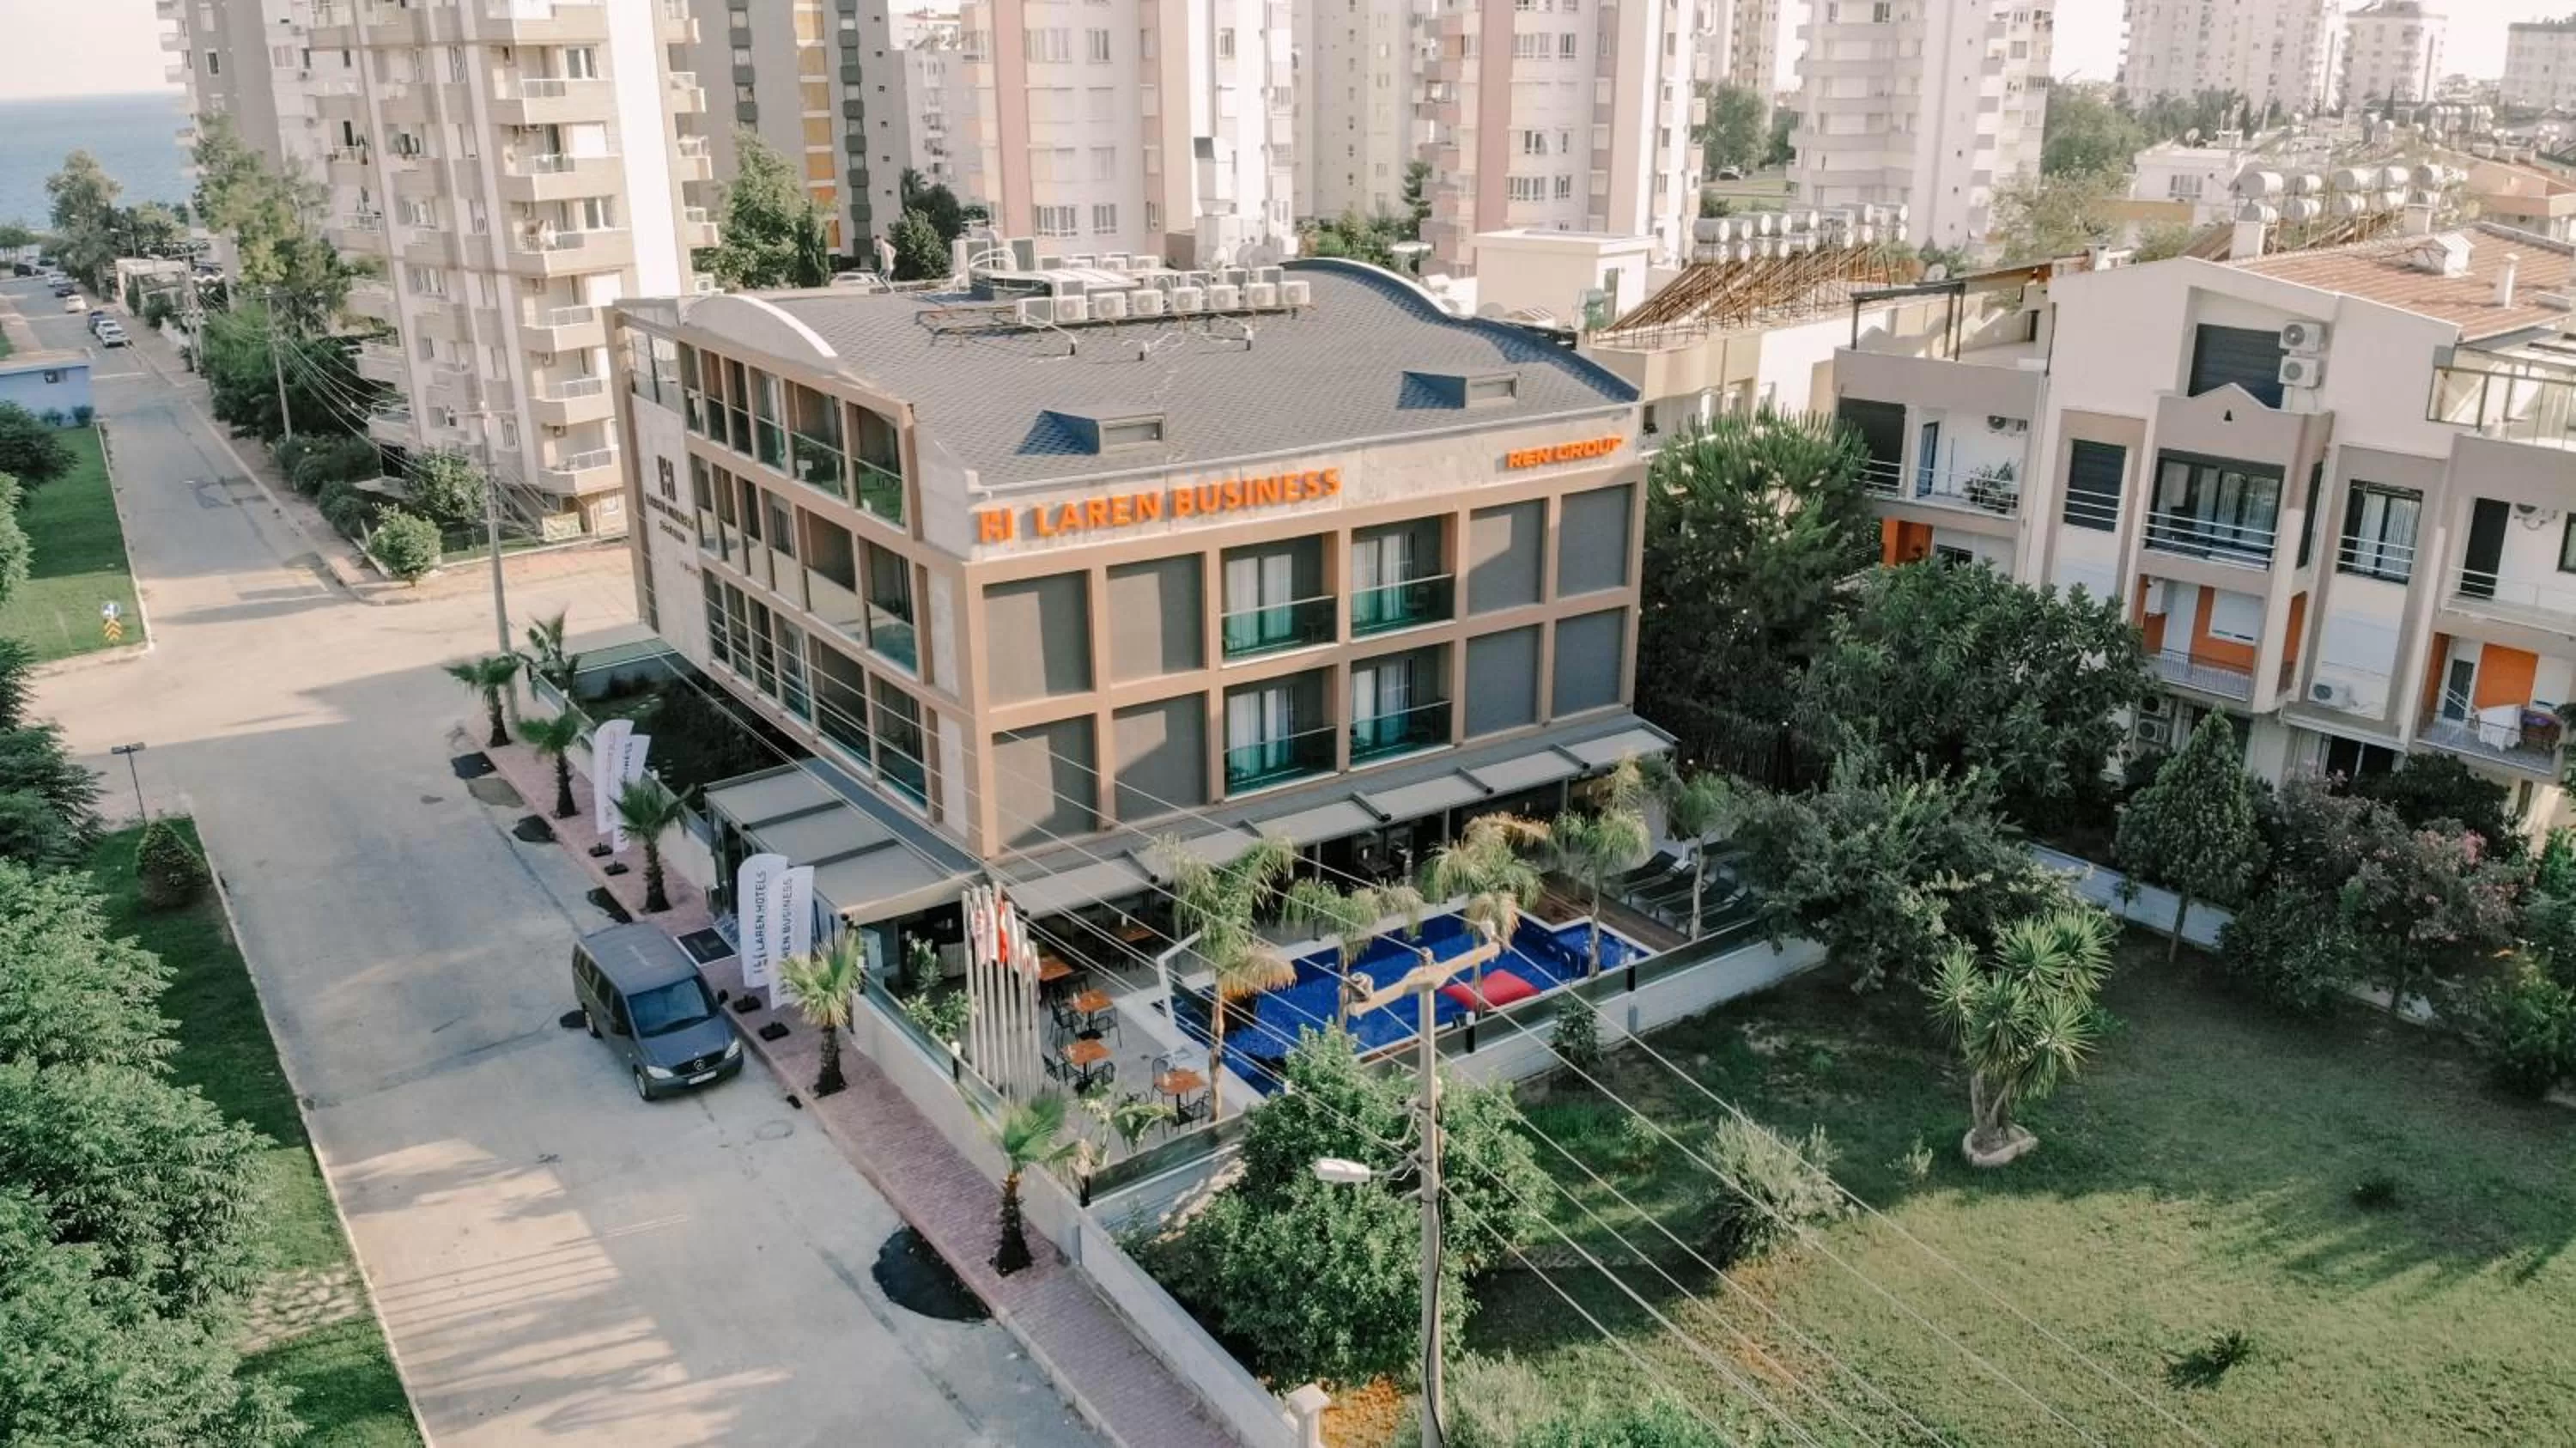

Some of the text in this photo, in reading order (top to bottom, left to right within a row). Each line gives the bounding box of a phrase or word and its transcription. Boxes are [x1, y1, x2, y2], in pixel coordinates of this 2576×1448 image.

[1508, 447, 1552, 468] REN
[1034, 491, 1161, 537] LAREN
[1173, 467, 1343, 518] BUSINESS
[755, 870, 767, 914] HOTELS
